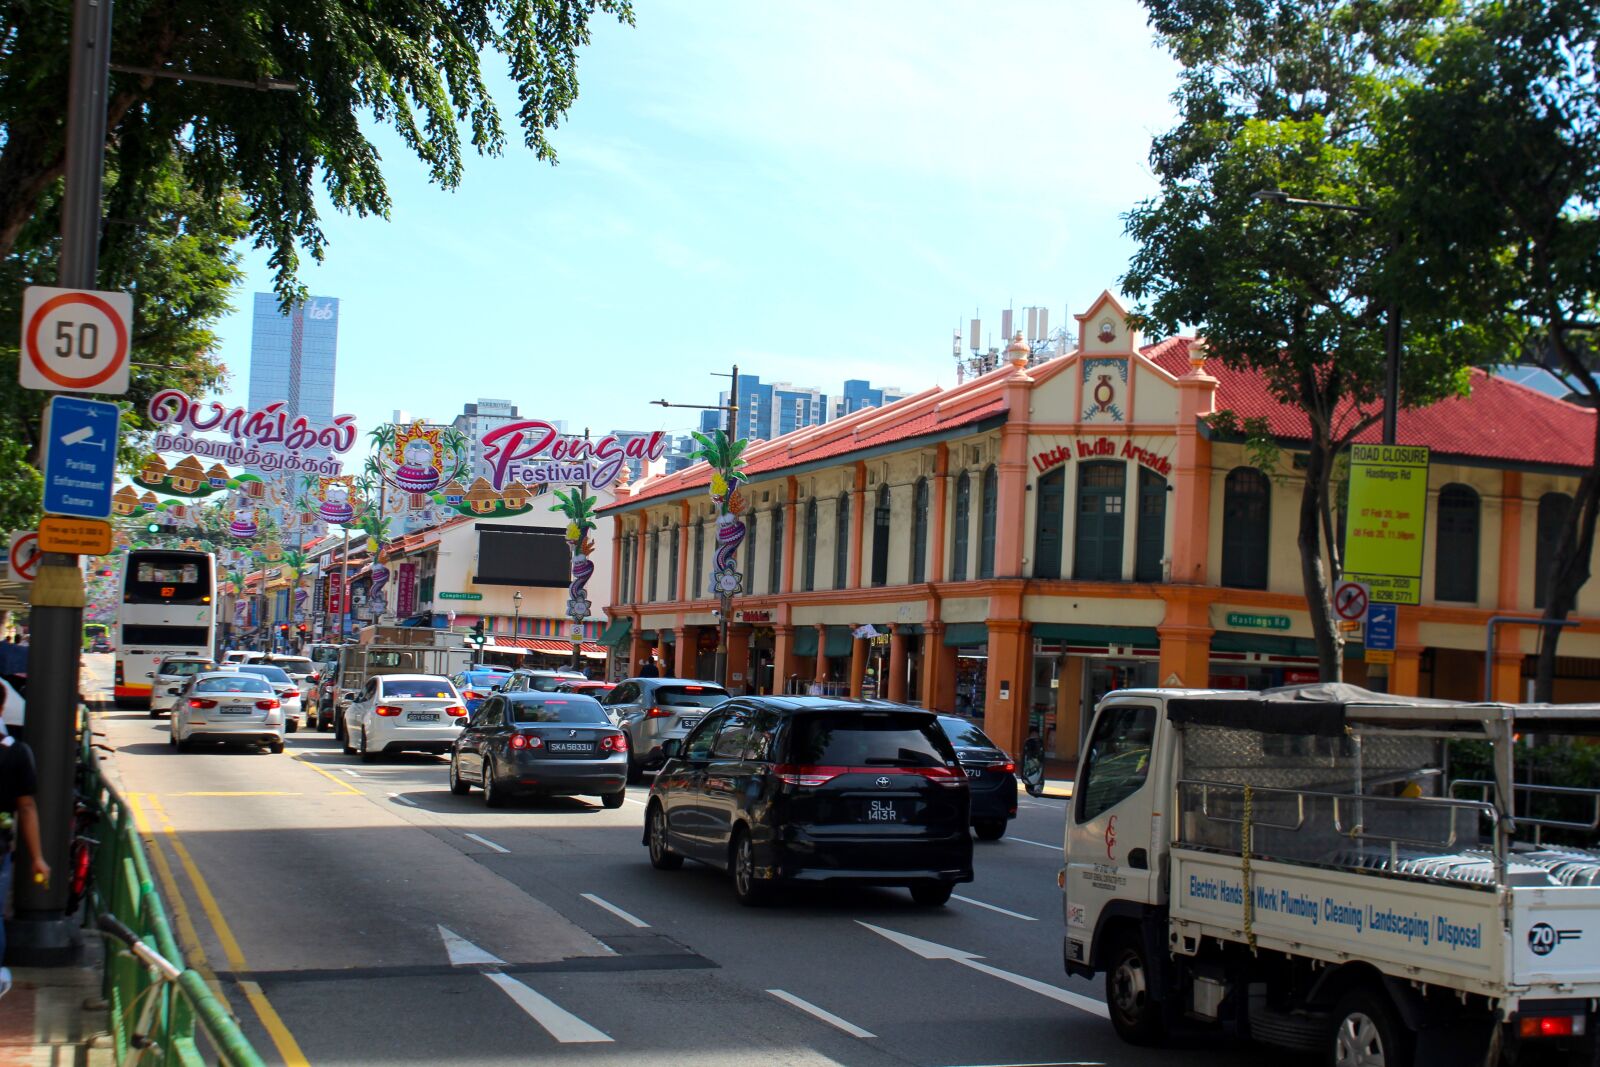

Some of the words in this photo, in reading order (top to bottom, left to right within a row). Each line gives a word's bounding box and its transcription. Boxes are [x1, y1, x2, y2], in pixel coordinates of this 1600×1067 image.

[55, 321, 99, 359] 50
[150, 390, 357, 453] பொங்கல்
[479, 420, 667, 491] Pongal
[1032, 445, 1072, 473] Little
[1076, 437, 1116, 458] India
[1120, 439, 1172, 476] Arcade
[1353, 447, 1380, 461] ROAD
[1382, 448, 1427, 463] CLOSURE
[65, 458, 96, 474] Parking
[508, 462, 592, 483] Festival
[1365, 468, 1399, 481] Hastings
[1401, 470, 1412, 480] Rd
[53, 475, 105, 490] Enforcement
[62, 494, 94, 507] Camera
[1231, 615, 1273, 628] Hastings
[1275, 617, 1287, 627] Rd
[871, 800, 893, 811] SLJ
[1220, 880, 1243, 905] Hands
[1281, 889, 1318, 926] Plumbing
[1324, 897, 1363, 933] Cleaning
[1369, 904, 1429, 946] Landscaping
[1437, 915, 1481, 950] Disposal
[1532, 927, 1553, 945] 70
